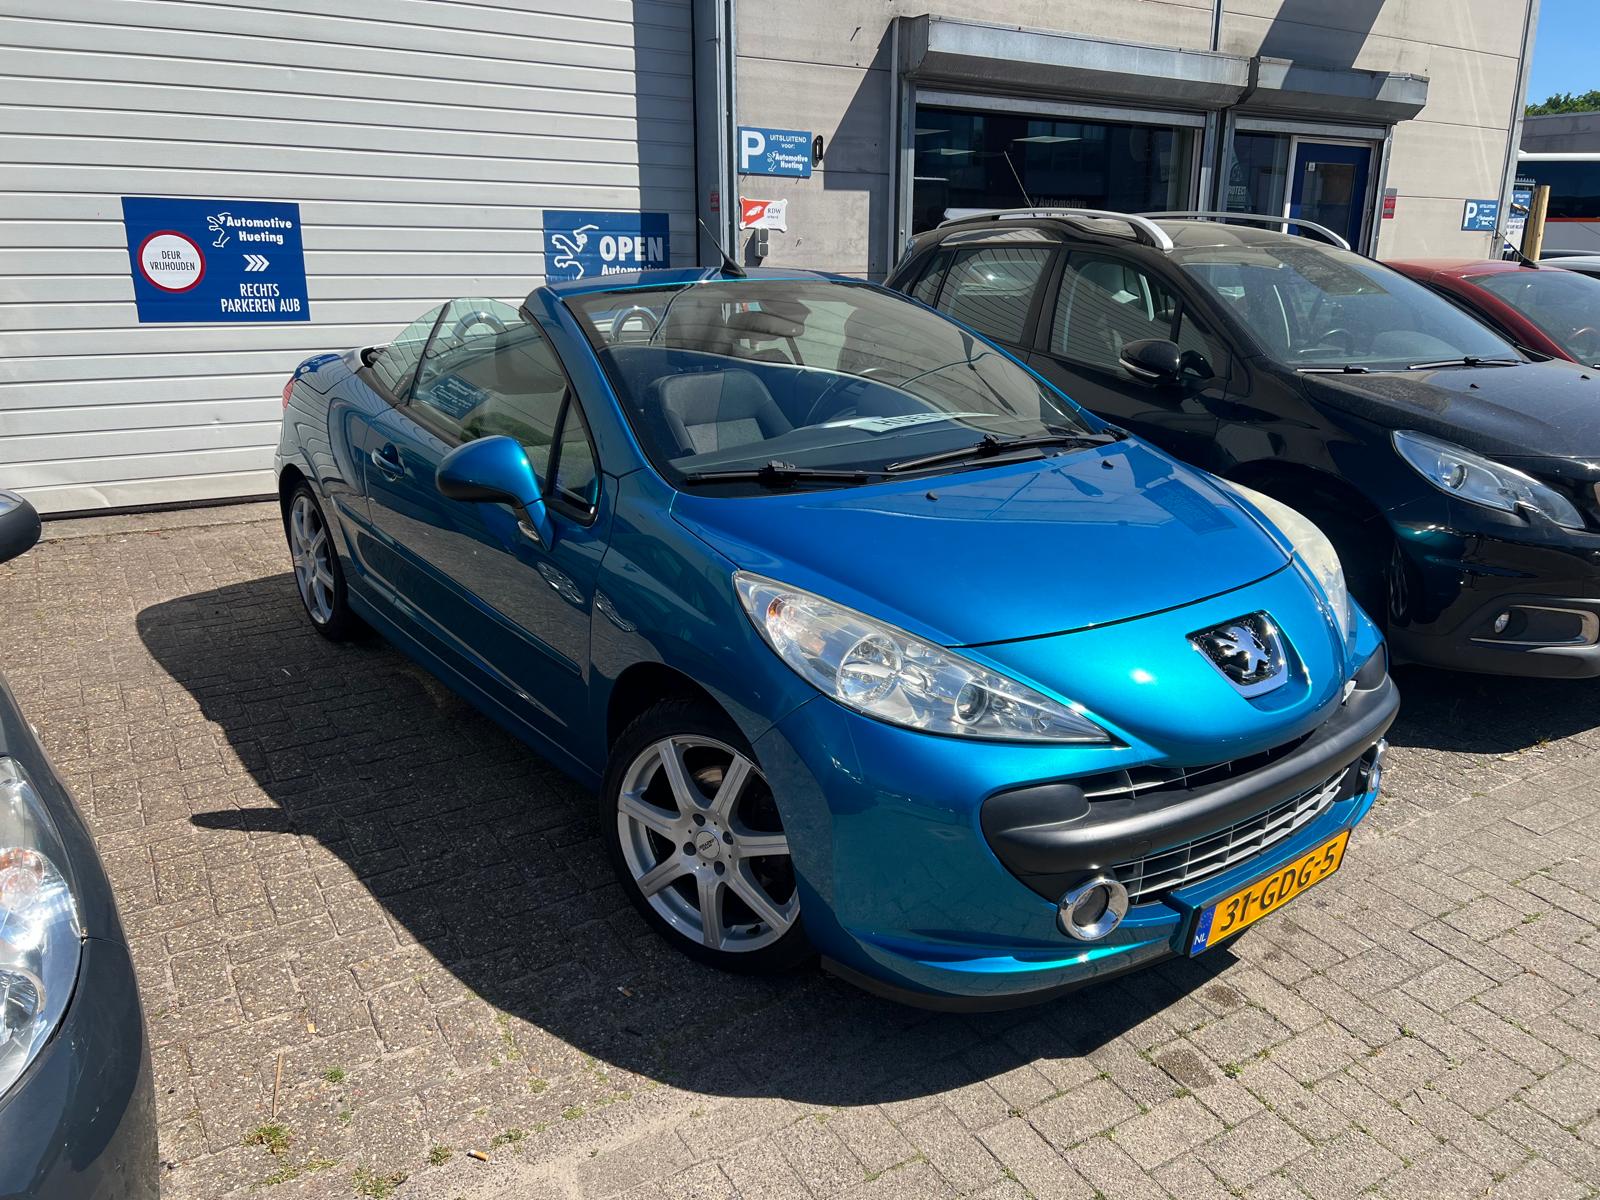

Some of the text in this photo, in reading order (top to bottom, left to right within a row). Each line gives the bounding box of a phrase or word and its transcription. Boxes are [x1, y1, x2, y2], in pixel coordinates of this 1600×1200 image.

[769, 134, 807, 144] UITSLUITEND
[741, 130, 766, 169] P
[775, 153, 808, 163] Automotive
[780, 160, 803, 171] Hueting
[767, 207, 781, 215] RDW
[226, 217, 293, 229] Automotive
[238, 231, 284, 245] Hueting
[600, 235, 664, 262] OPEN
[161, 250, 182, 260] DEUR
[150, 261, 196, 272] VRIJHOUDEN
[601, 264, 663, 276] Automoti
[239, 283, 280, 297] RECHTS
[221, 298, 301, 313] PARKEREN AUB
[1219, 842, 1338, 932] 31-GDG-5
[1194, 932, 1207, 946] NL
